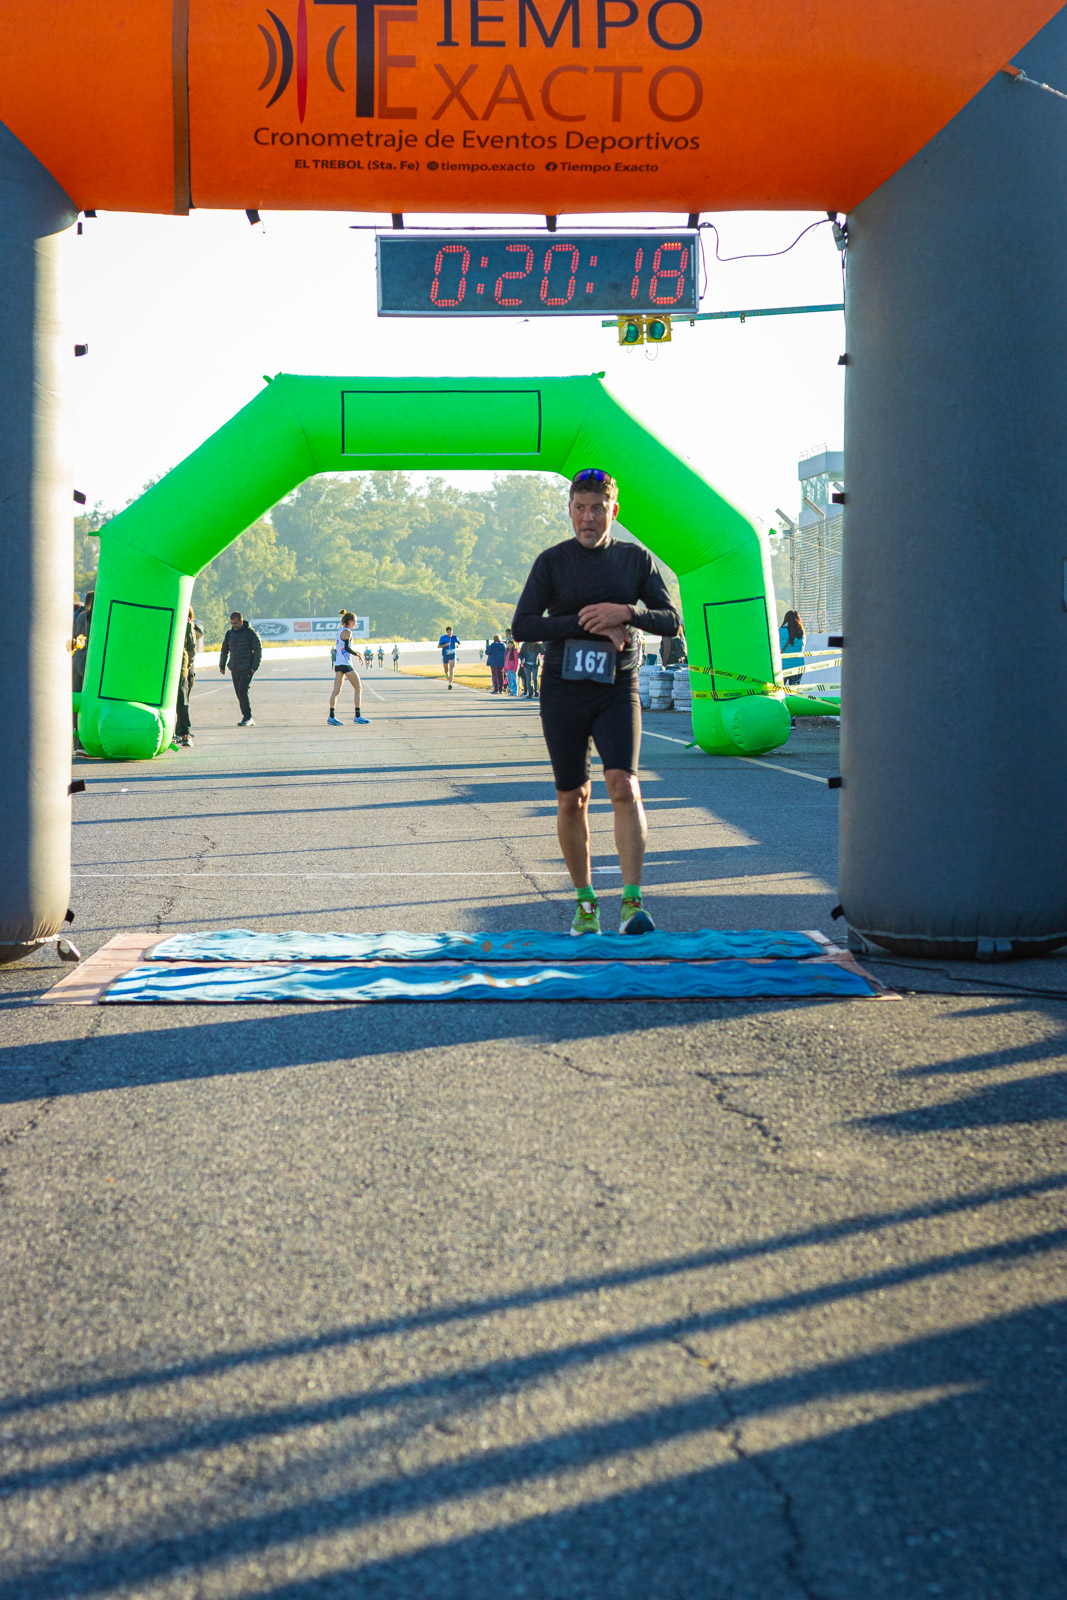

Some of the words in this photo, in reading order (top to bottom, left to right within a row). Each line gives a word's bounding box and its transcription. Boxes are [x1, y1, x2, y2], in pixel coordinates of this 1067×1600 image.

[253, 127, 418, 152] Cronometraje
[424, 129, 455, 149] de
[462, 130, 558, 150] Eventos
[565, 130, 700, 154] Deportivos
[294, 159, 310, 169] EL
[312, 159, 364, 170] TREBOL
[367, 160, 397, 171] (Sta.
[399, 161, 420, 171] Fe)
[440, 160, 536, 173] tiempo.exacto
[560, 162, 611, 174] Tiempo
[614, 163, 659, 172] Exacto
[258, 623, 282, 634] Ford
[574, 649, 607, 674] 167
